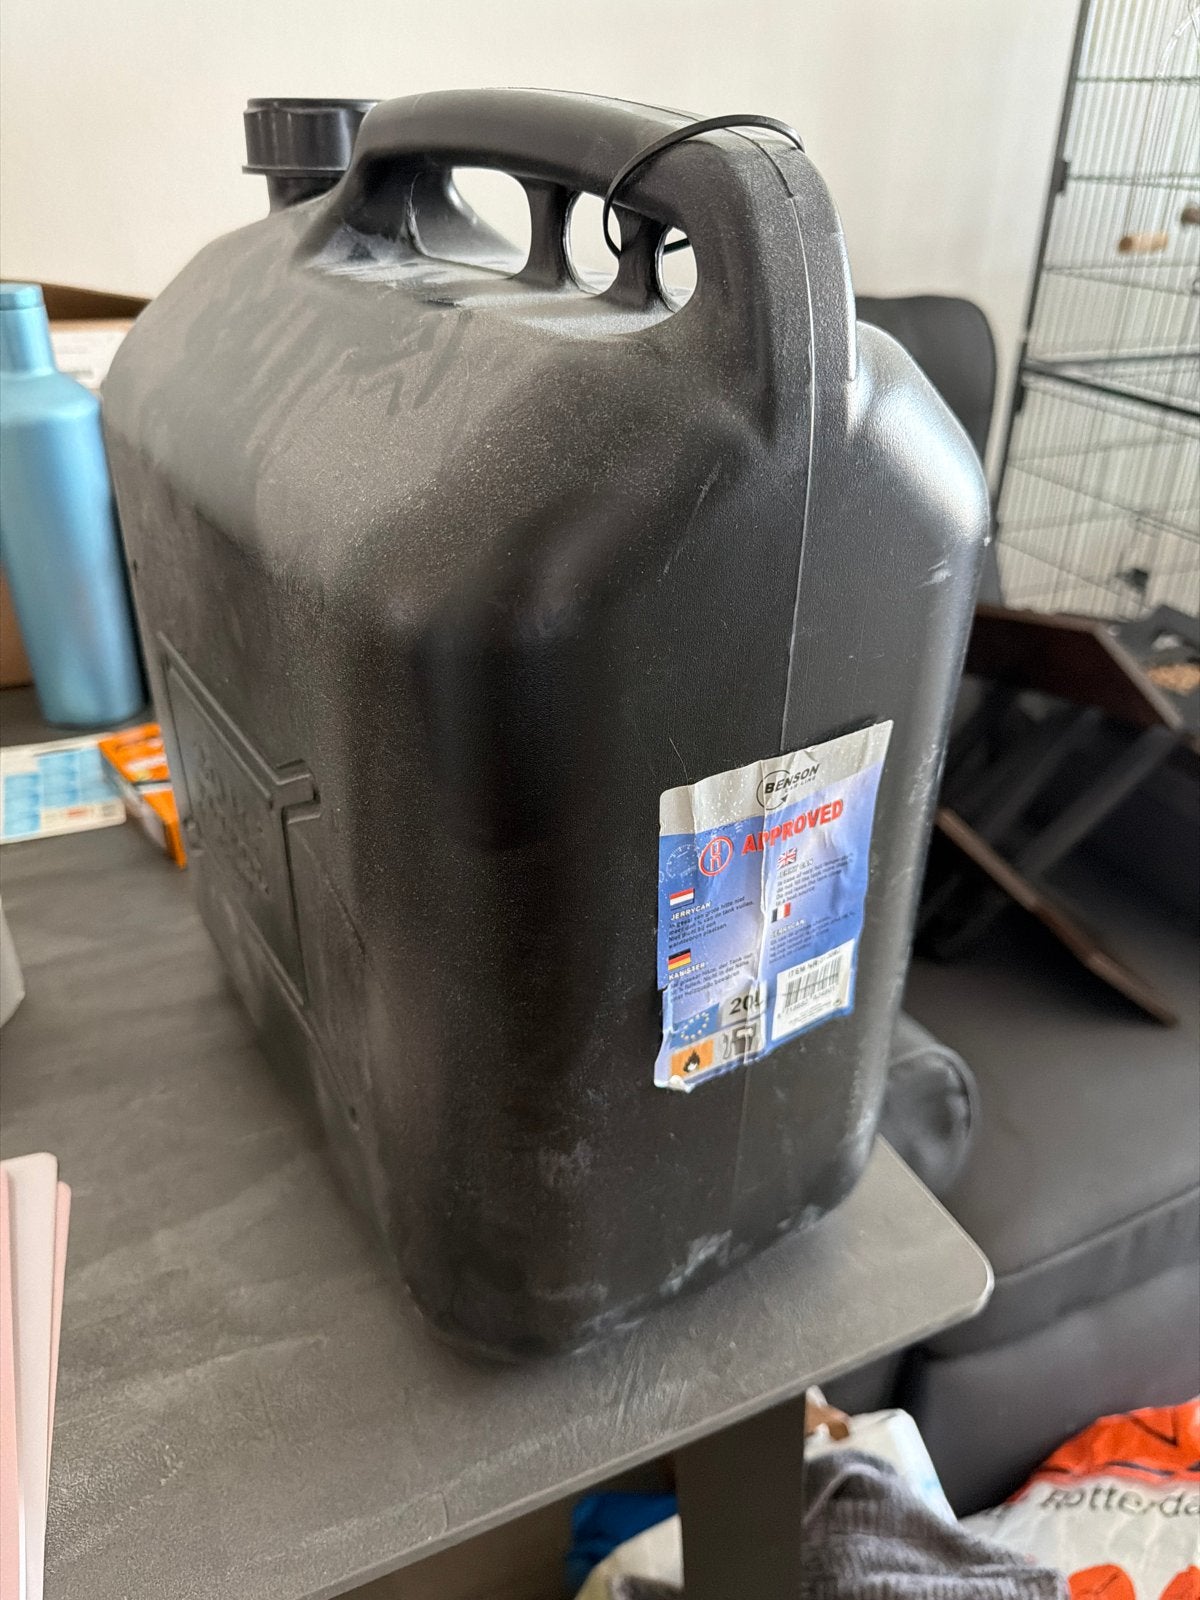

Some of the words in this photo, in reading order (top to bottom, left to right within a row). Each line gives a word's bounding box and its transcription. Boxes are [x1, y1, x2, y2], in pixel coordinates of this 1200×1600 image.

[765, 763, 822, 794] BENSON
[741, 799, 844, 856] APPROVED
[670, 901, 711, 921] JERRYCAN
[668, 961, 706, 981] KANISTER
